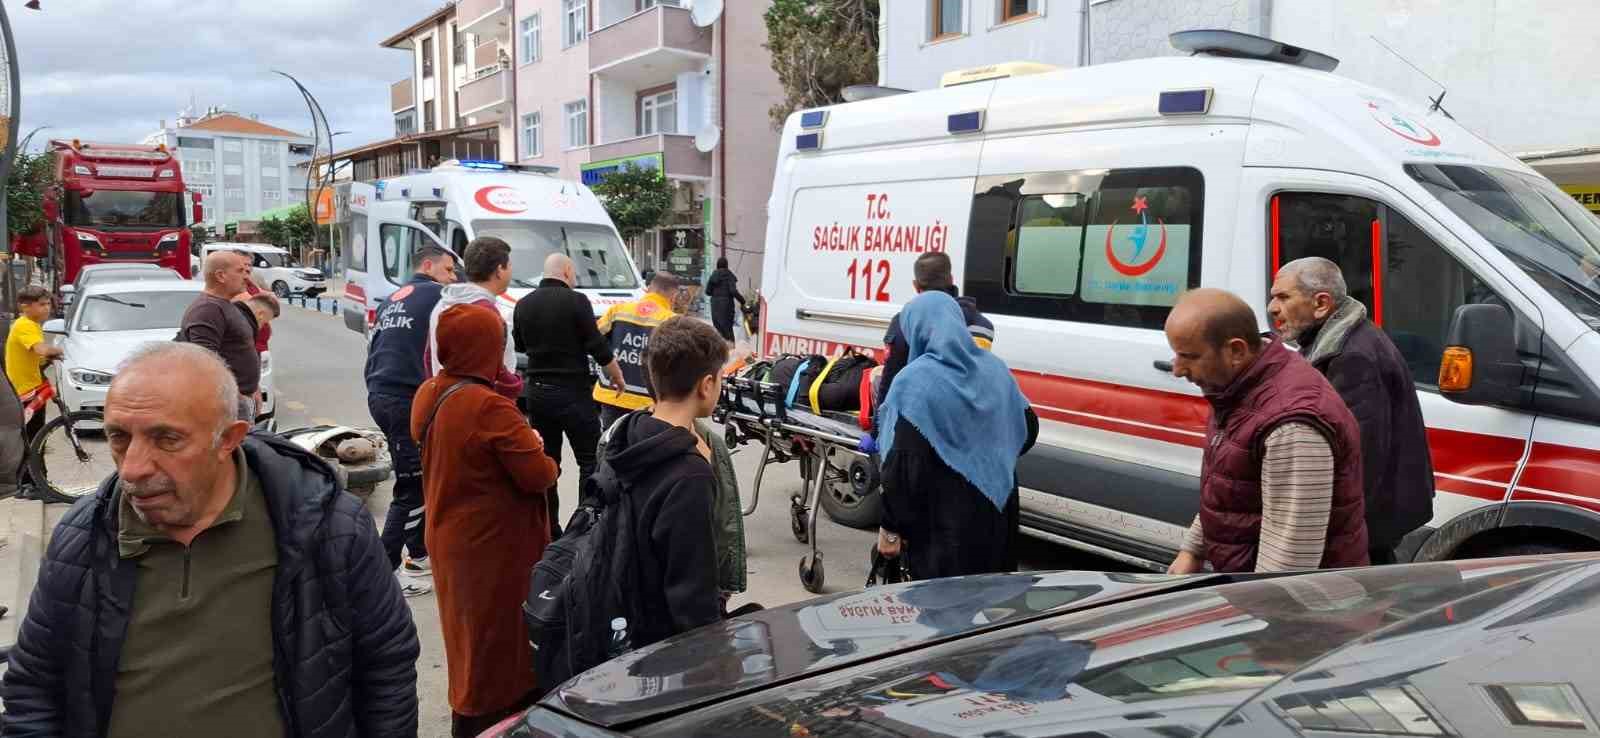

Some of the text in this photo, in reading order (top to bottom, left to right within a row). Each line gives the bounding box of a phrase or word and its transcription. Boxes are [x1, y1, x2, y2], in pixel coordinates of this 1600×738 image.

[866, 193, 891, 219] T.C.
[813, 219, 948, 253] SAĞLIK BAKANLIĞI
[847, 258, 891, 302] 112
